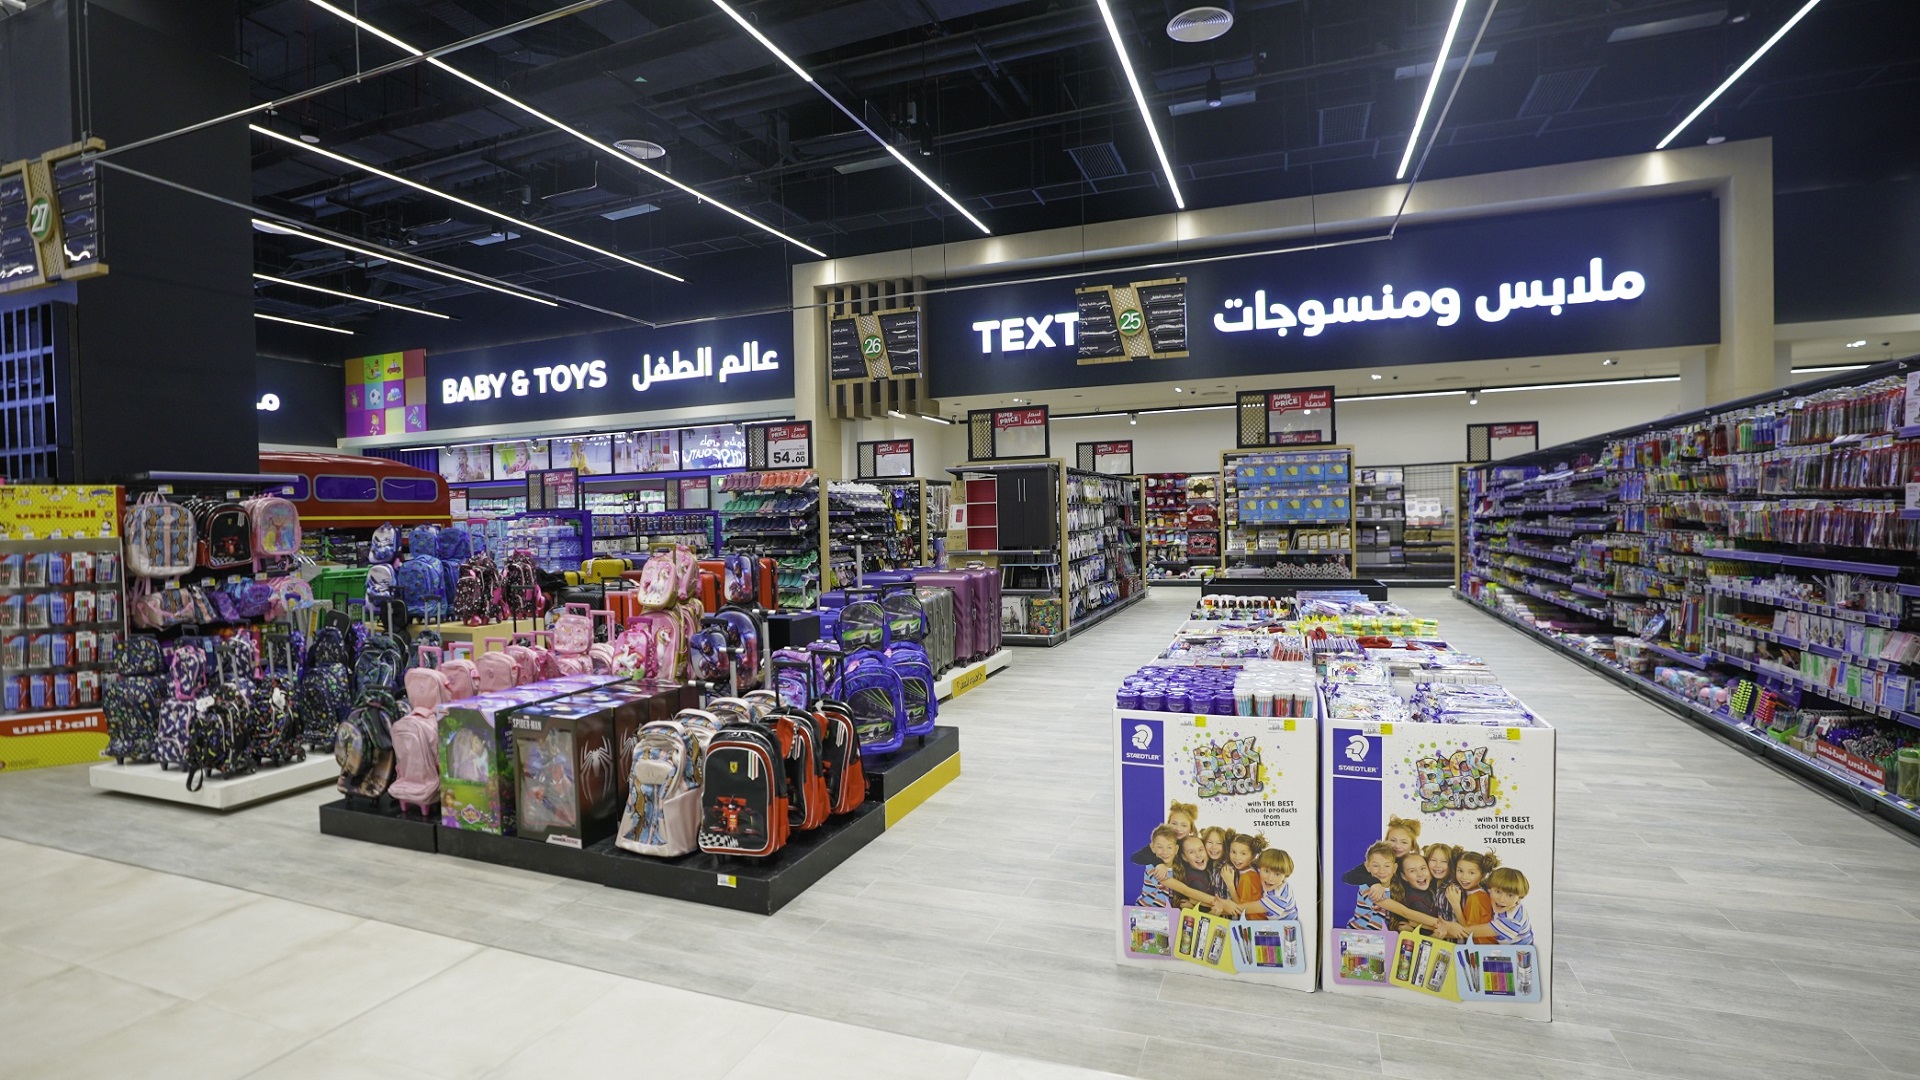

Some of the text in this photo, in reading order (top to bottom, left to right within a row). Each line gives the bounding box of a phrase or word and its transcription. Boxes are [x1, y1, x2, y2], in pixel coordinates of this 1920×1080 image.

[31, 203, 49, 233] 27
[1213, 257, 1646, 337] ملابس ومنسوجات
[1120, 312, 1141, 330] 25
[972, 311, 1080, 354] TEXT
[864, 337, 881, 354] 26
[632, 341, 779, 392] عالم الطفل
[442, 359, 607, 404] BABY & TOYS
[1275, 398, 1298, 407] PRICE
[999, 416, 1018, 425] PRICE
[512, 717, 542, 731] SPIDER-MAN
[1126, 752, 1160, 761] STAEDTLER
[1416, 746, 1494, 784] BACK
[1338, 764, 1378, 774] STAEDTLER
[1483, 837, 1526, 845] STAEDTLER
